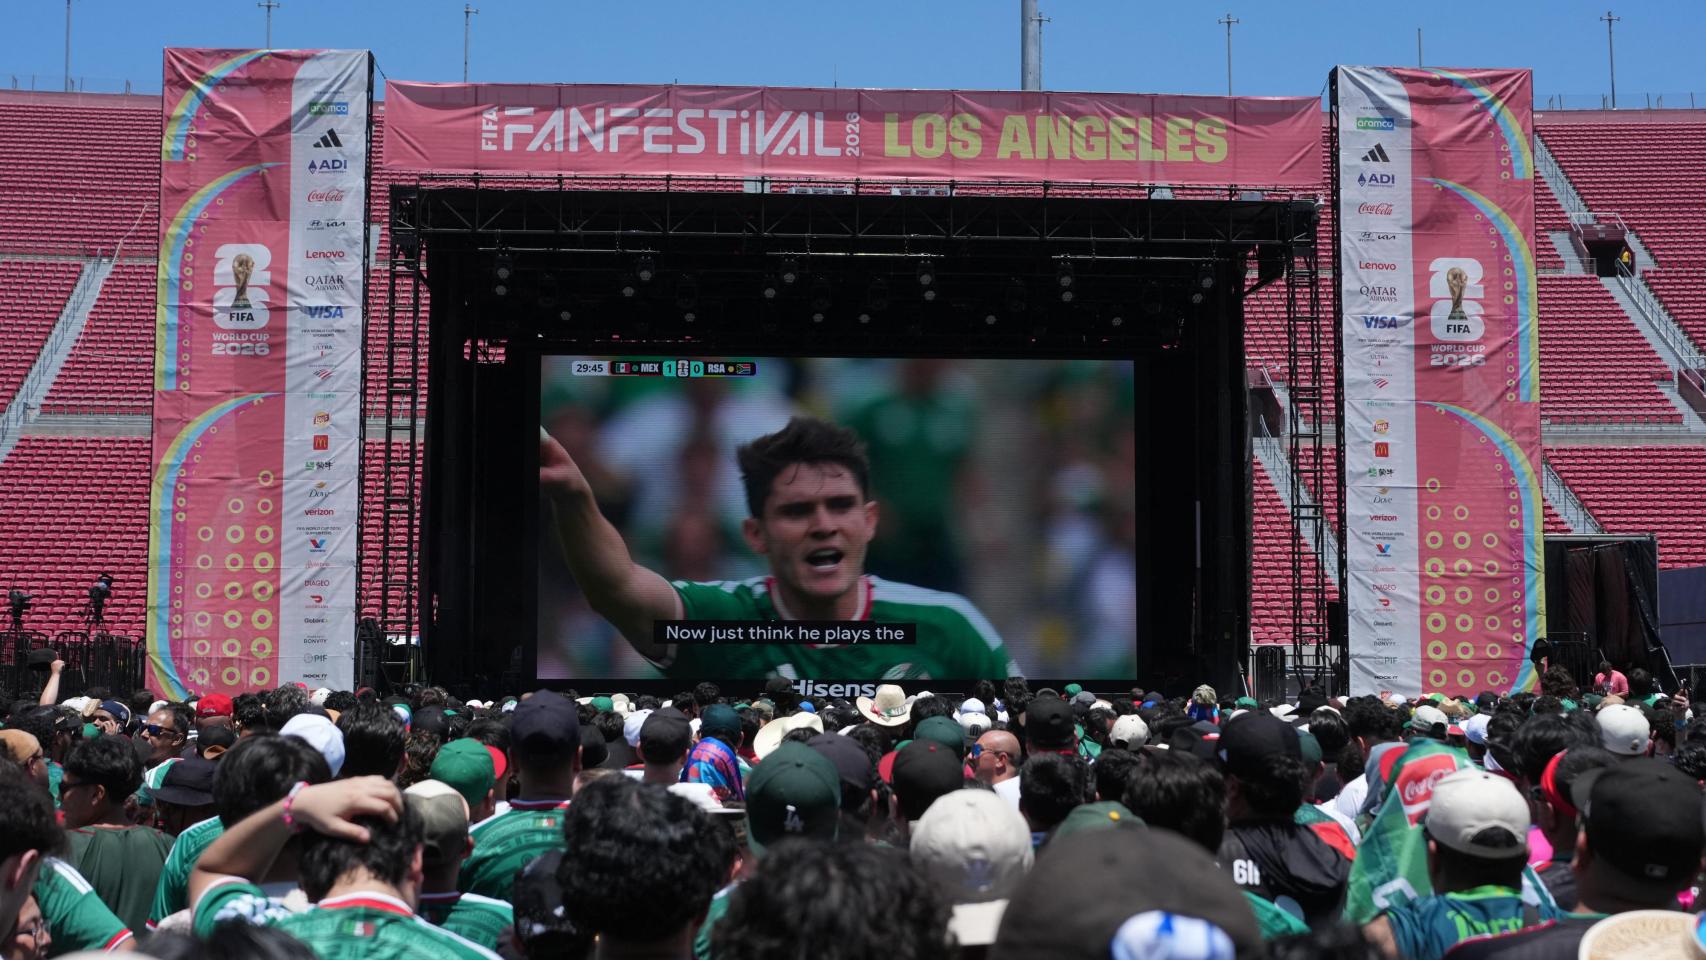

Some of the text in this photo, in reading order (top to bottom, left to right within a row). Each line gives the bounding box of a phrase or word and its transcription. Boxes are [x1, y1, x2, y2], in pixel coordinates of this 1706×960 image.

[481, 106, 499, 151] FIFA
[1357, 120, 1393, 128] aramco
[845, 112, 860, 157] 2026
[884, 112, 1229, 163] LOS ANGELES
[319, 159, 348, 170] ADI
[1368, 173, 1395, 184] ADI
[306, 249, 345, 259] Lenovo
[1359, 260, 1397, 271] Lenovo
[305, 274, 345, 287] QATAR
[1360, 285, 1397, 297] QATAR
[1370, 295, 1397, 303] AIRWAYS
[229, 312, 255, 322] FIFA
[307, 306, 344, 319] VISA
[1363, 315, 1398, 329] VISA
[1446, 324, 1471, 334] FIFA
[212, 333, 270, 341] WORLD CUP
[211, 342, 270, 356] 2026
[1431, 344, 1486, 353] WORLD CUP
[1430, 353, 1486, 367] 2026
[576, 363, 725, 373] 29:45 MEX 1 0 RSA
[304, 508, 335, 516] verizon
[1369, 514, 1398, 522] verizon
[666, 625, 905, 644] Now just think he plays the
[314, 654, 328, 662] PIF
[1384, 656, 1398, 665] PIF
